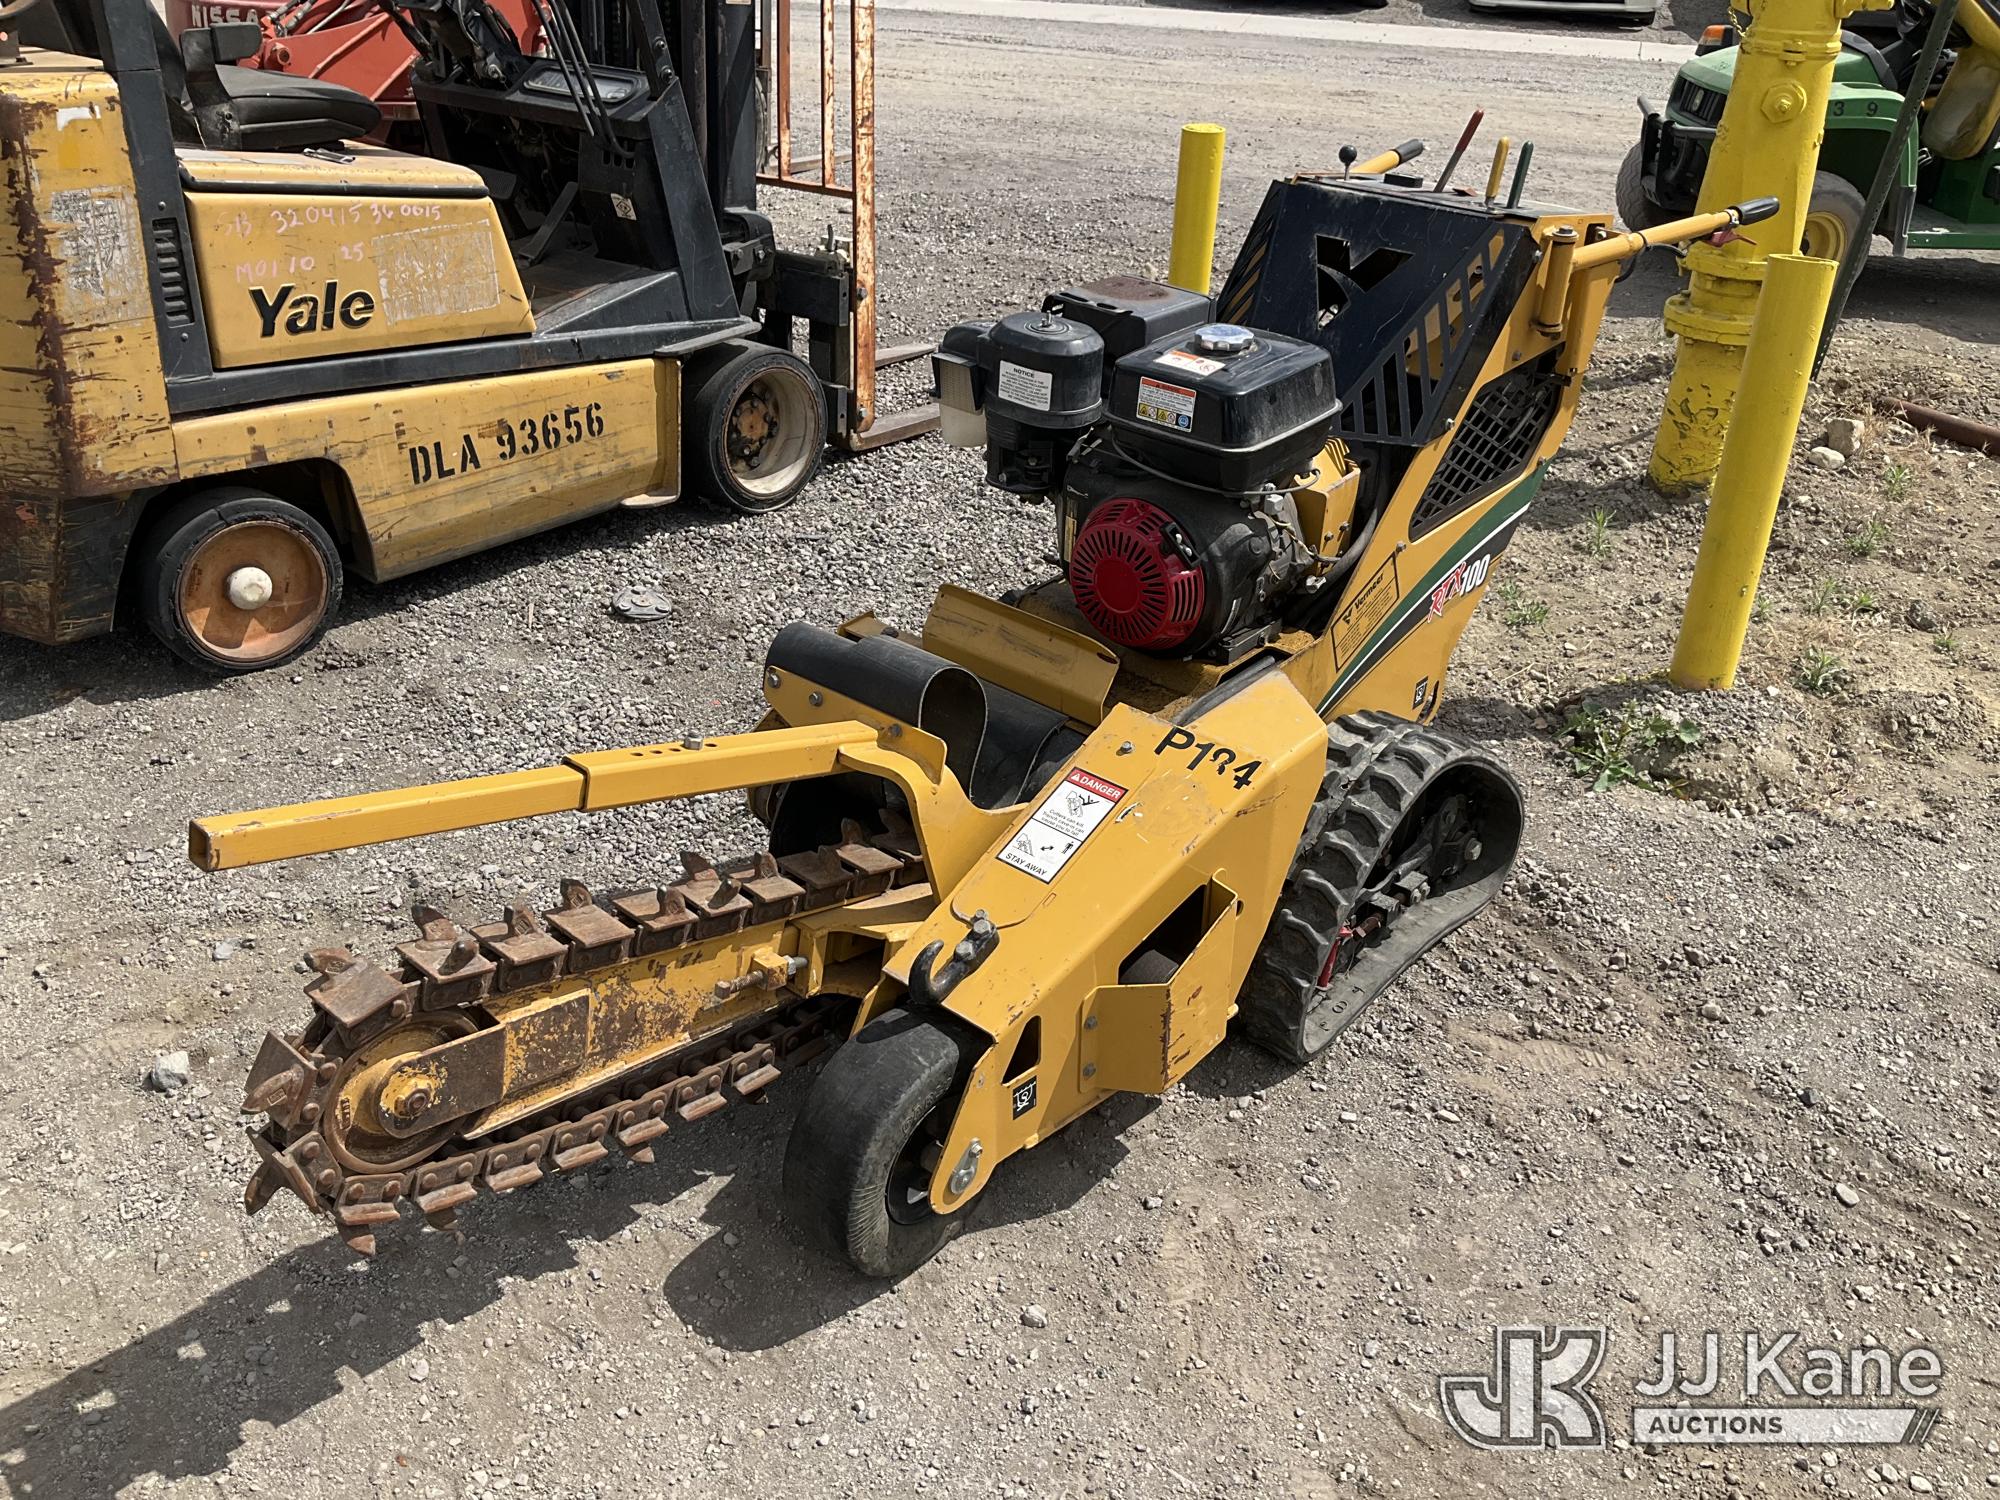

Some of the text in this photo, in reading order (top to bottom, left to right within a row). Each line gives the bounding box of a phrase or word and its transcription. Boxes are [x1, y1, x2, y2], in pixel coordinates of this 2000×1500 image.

[1833, 101, 1879, 117] 3 9
[340, 242, 364, 262] 25
[248, 279, 375, 339] Yale
[1013, 367, 1035, 379] NOTICE
[408, 402, 604, 485] DLA 93656
[1354, 573, 1384, 610] Vermeer
[1080, 776, 1121, 799] DANGER
[1005, 852, 1048, 876] STAY AWAY
